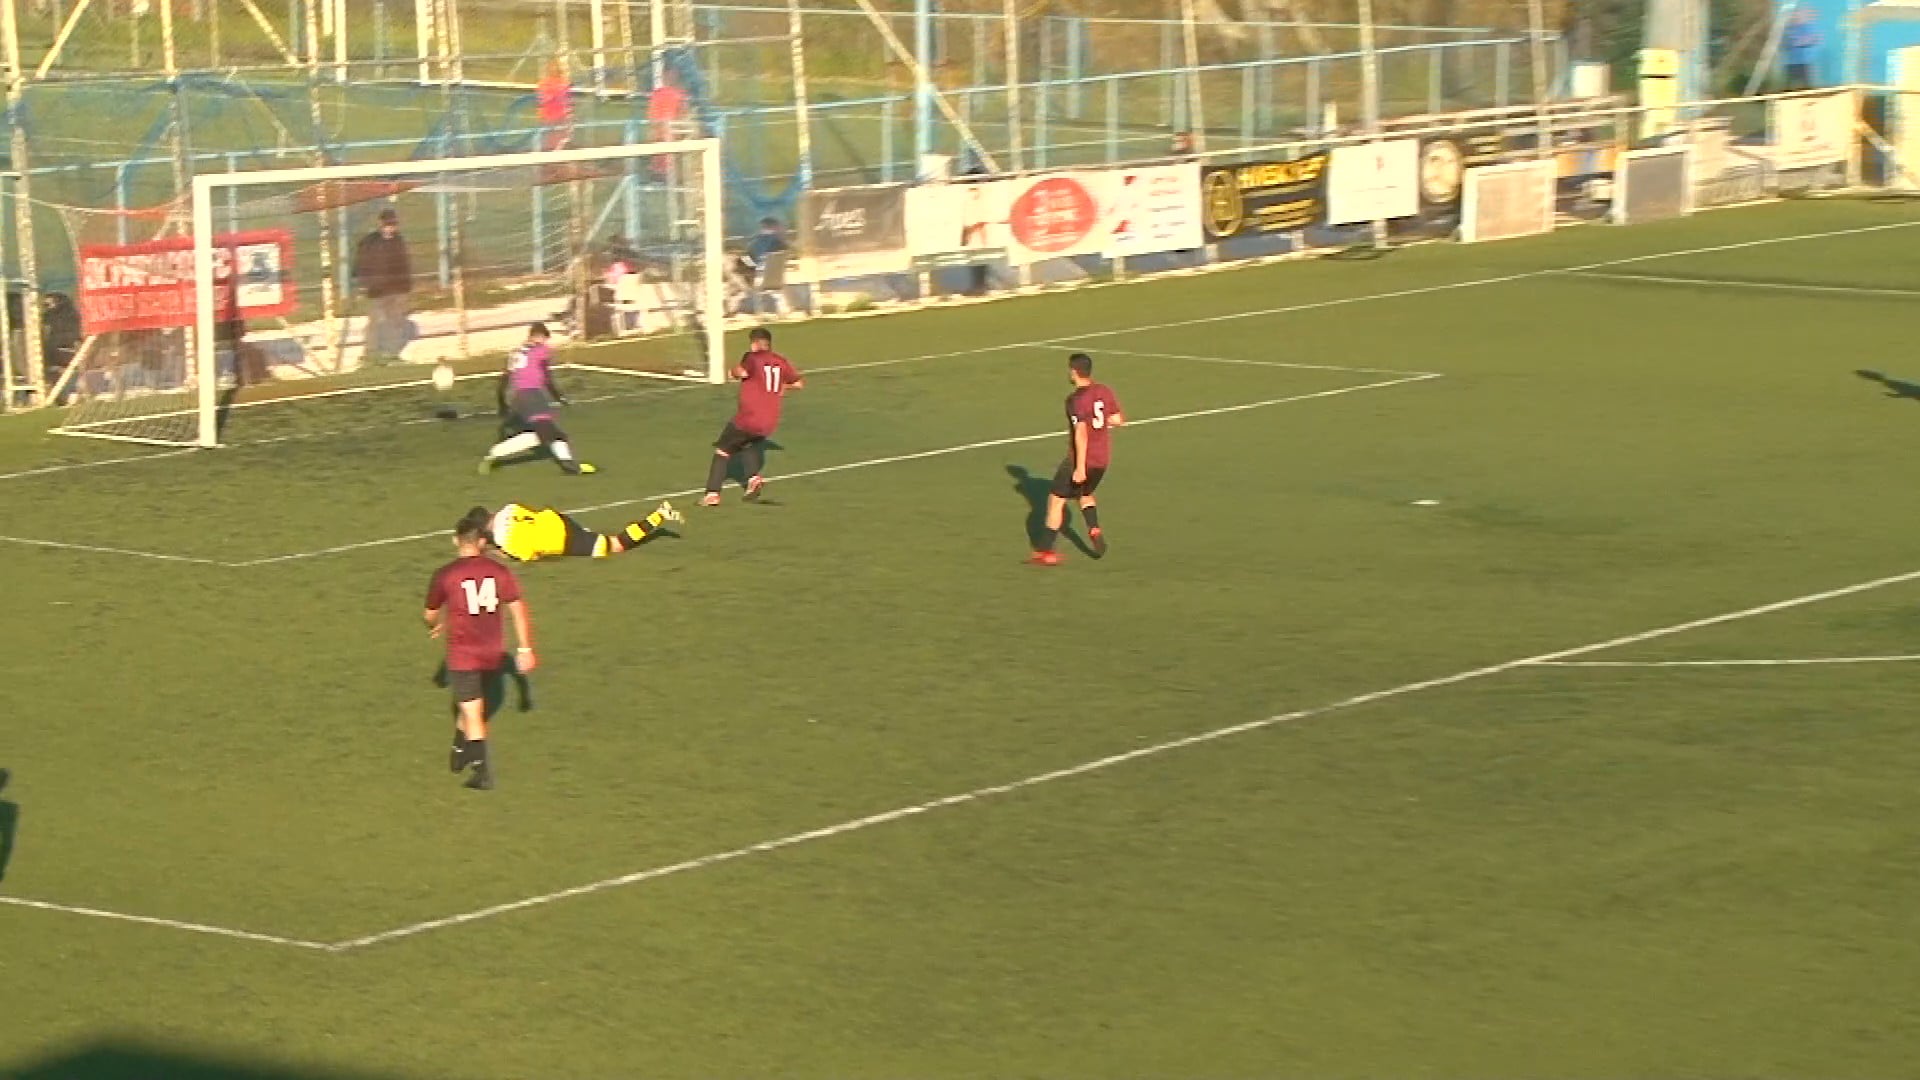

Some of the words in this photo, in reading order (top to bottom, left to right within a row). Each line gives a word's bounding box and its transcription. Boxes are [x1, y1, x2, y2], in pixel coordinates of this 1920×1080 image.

[763, 365, 781, 393] 11
[1092, 400, 1105, 429] 5
[461, 577, 499, 615] 14
